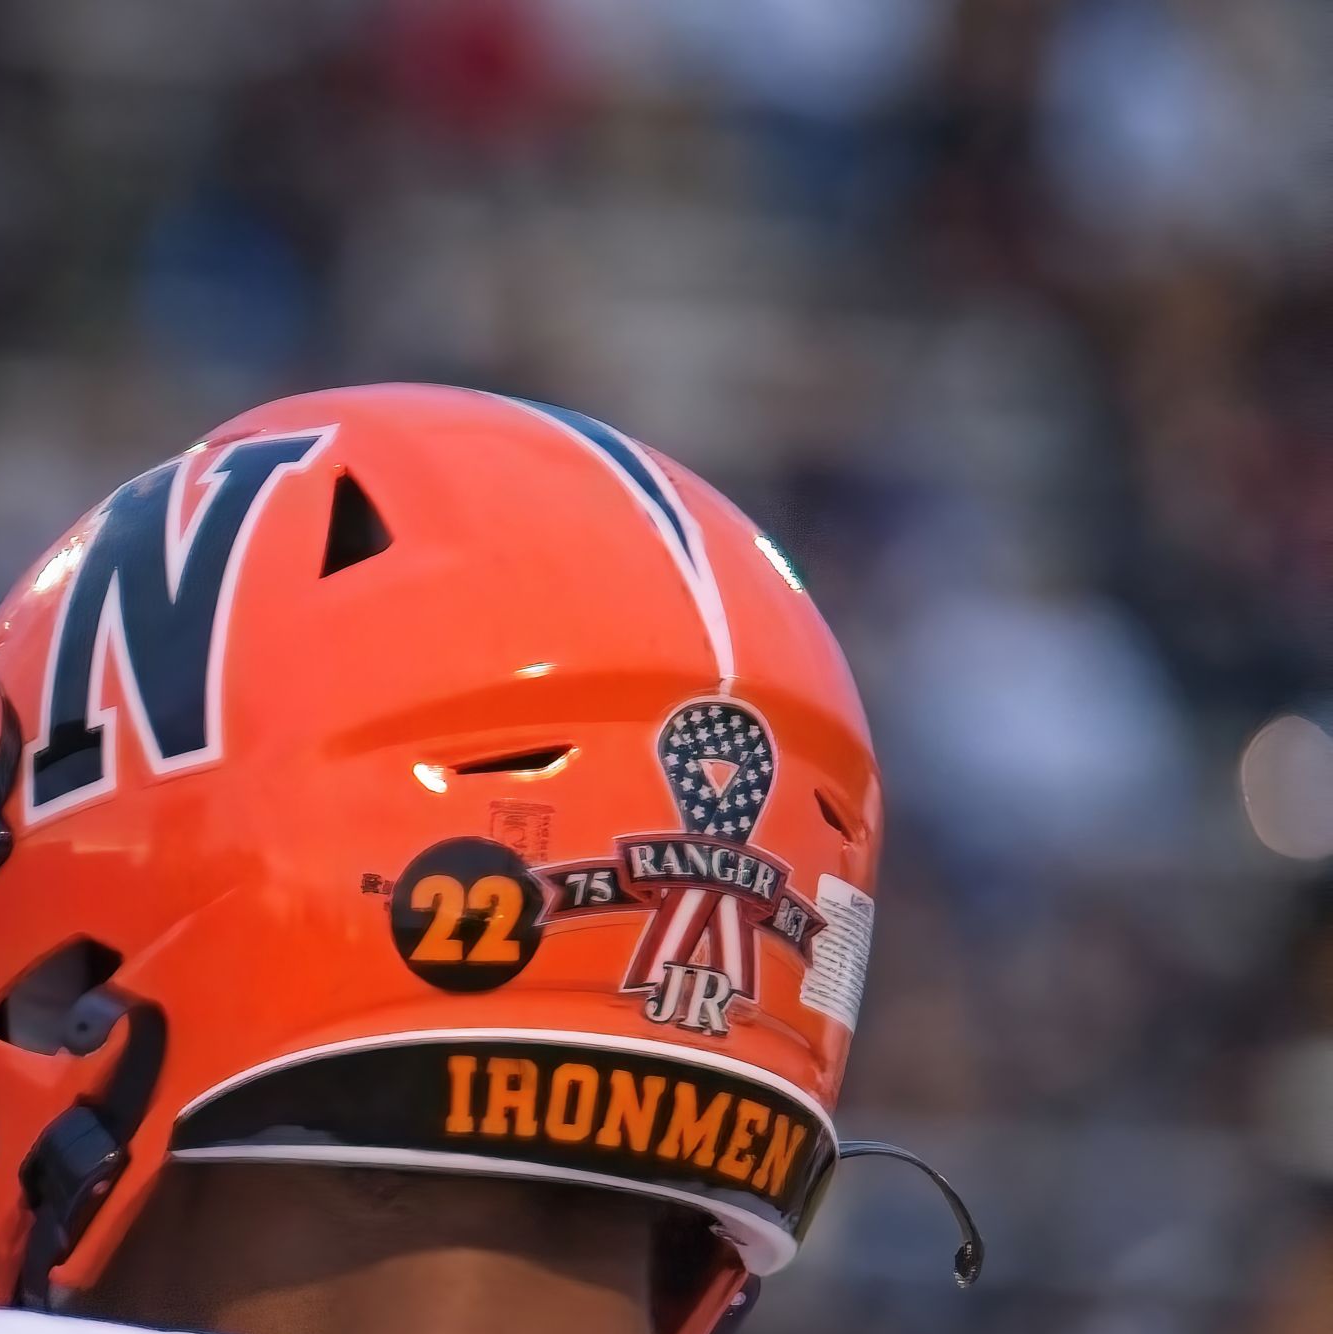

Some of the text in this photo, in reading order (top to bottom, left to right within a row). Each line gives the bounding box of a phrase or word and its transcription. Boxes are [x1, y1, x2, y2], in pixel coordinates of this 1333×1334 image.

[22, 422, 341, 826] N
[408, 873, 525, 964] 22
[565, 842, 777, 905] 75 RANGER
[644, 961, 731, 1036] JR
[445, 1054, 808, 1197] IRONMEN
